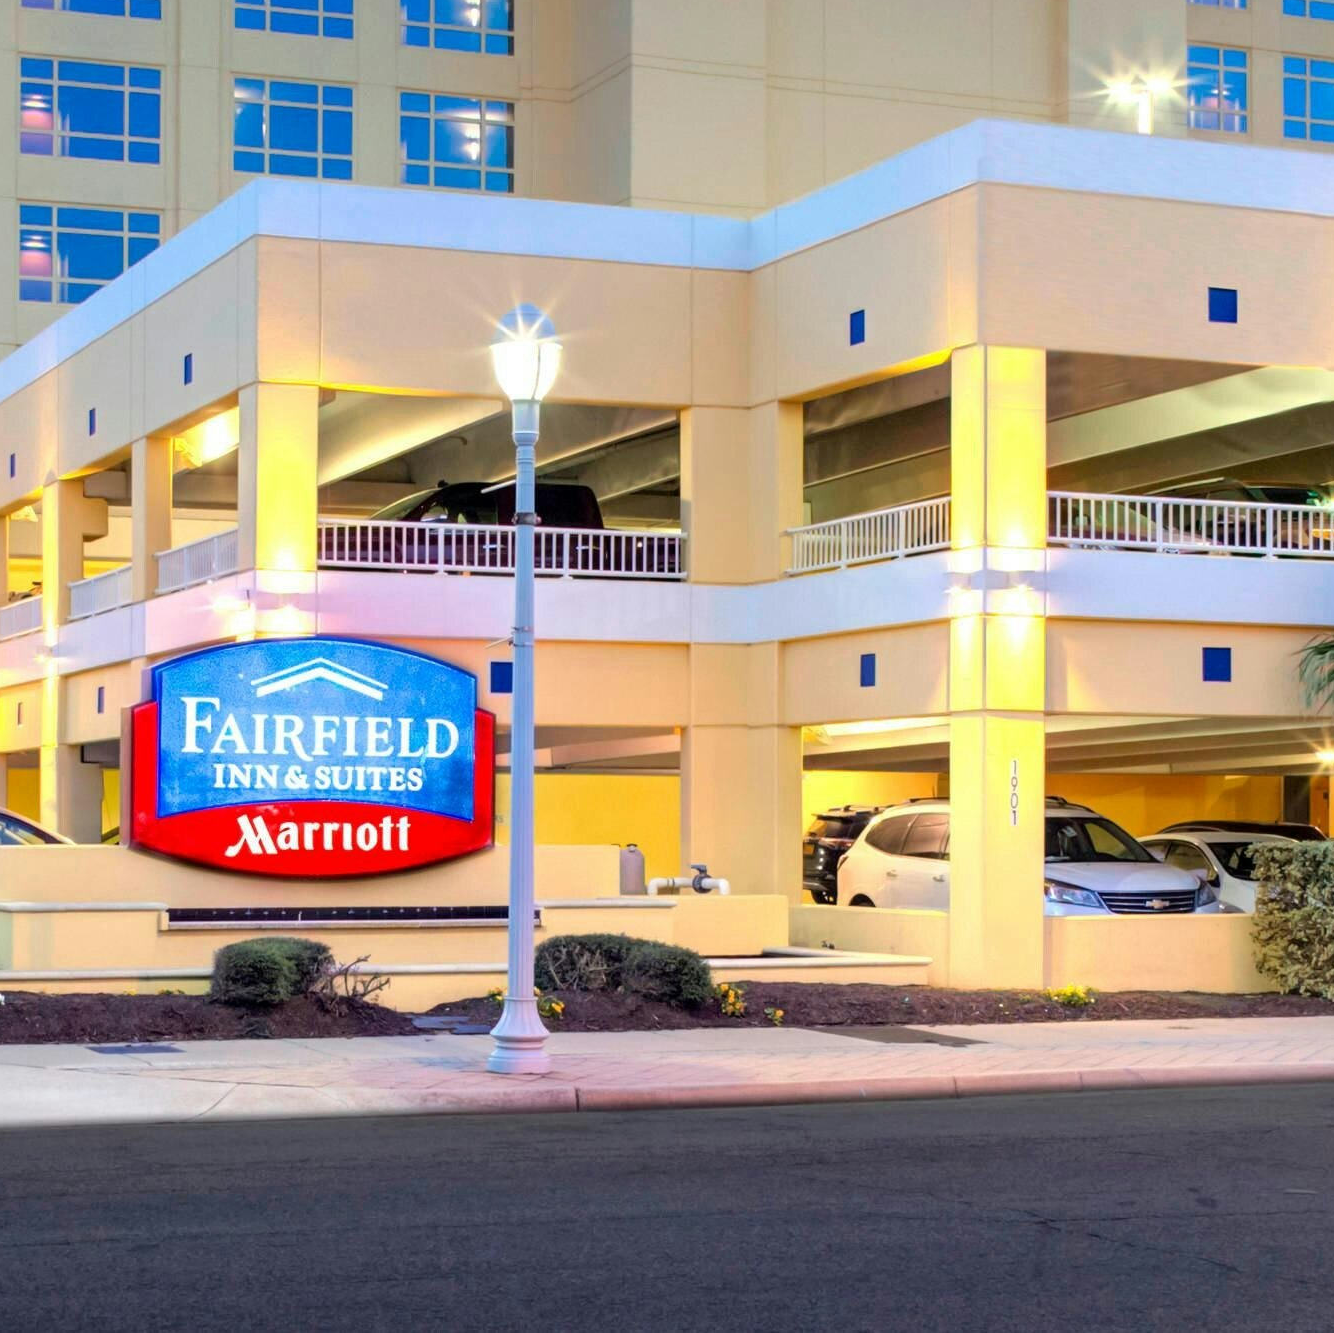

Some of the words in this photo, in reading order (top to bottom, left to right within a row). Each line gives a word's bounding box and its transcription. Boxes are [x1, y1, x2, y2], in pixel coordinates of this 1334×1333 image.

[180, 696, 460, 762] FAIRFIELD
[213, 764, 281, 789] INN
[284, 767, 311, 790] &
[315, 766, 424, 792] SUITES
[1010, 759, 1019, 826] 1901
[224, 814, 412, 858] Marriott
